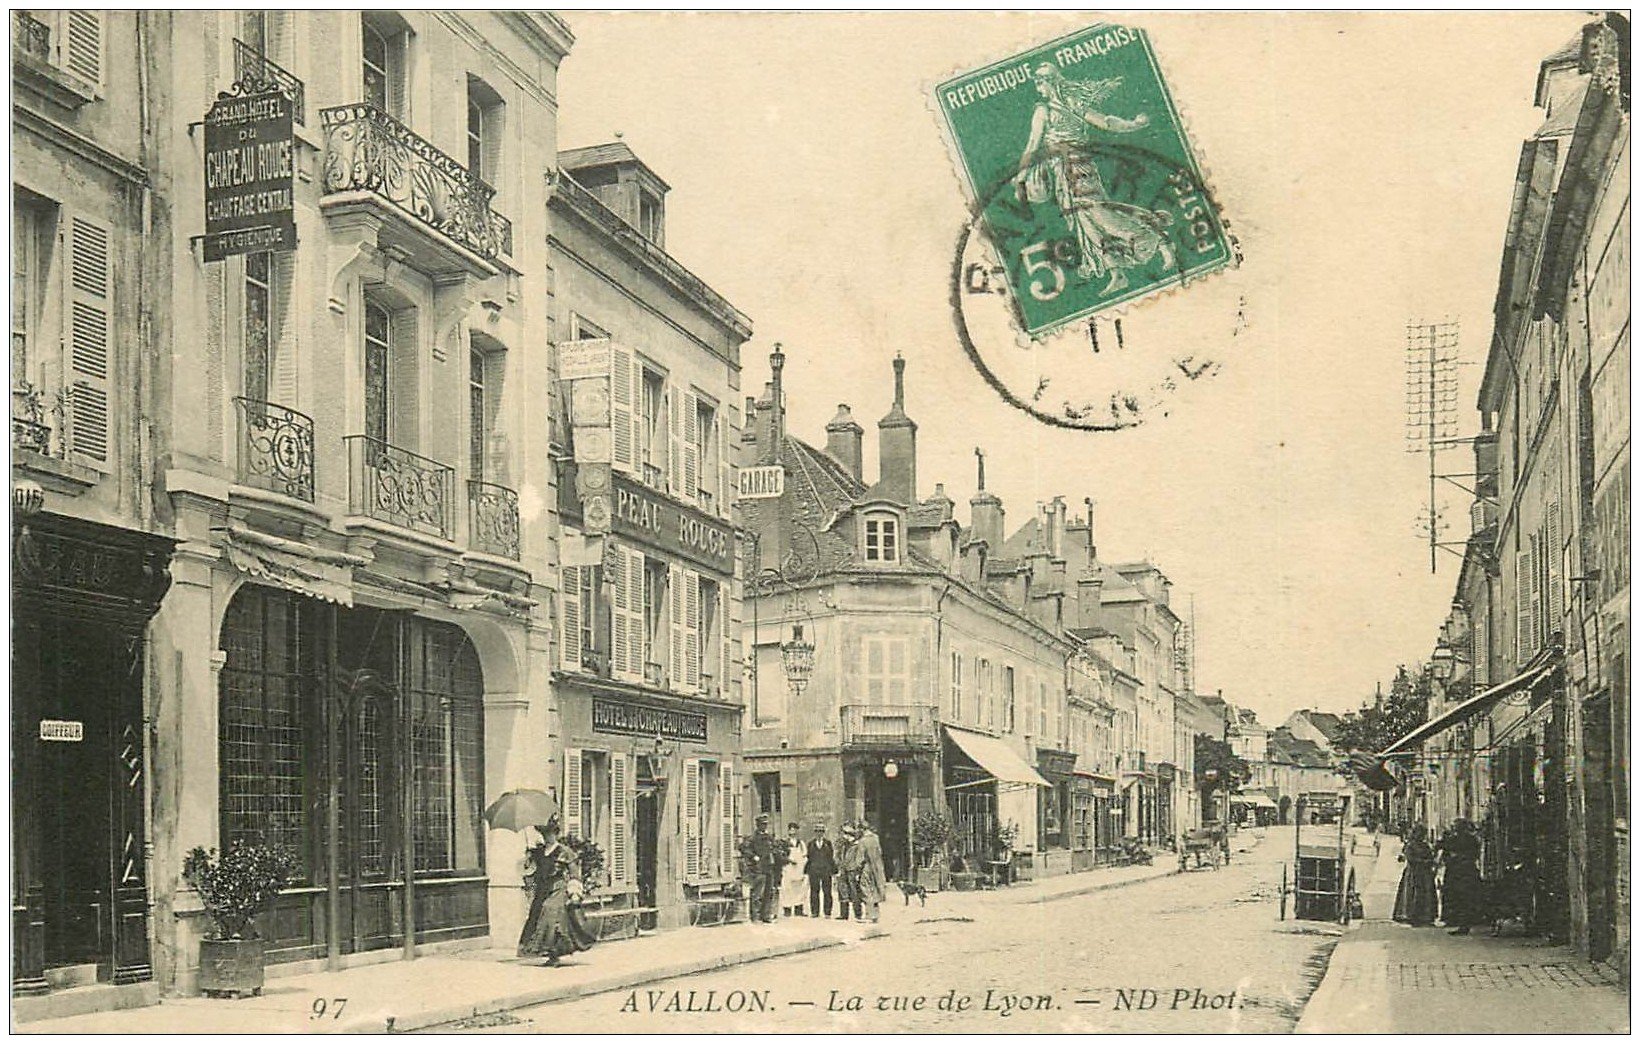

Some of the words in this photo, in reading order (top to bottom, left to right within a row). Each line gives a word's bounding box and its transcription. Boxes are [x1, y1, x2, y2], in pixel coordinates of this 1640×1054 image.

[1054, 26, 1139, 68] FRANÇAISE
[214, 102, 246, 127] GRAND
[249, 98, 284, 121] HOTEL
[239, 129, 256, 141] DU
[207, 147, 255, 188] CHAPEAU
[258, 139, 292, 181] ROUGE
[207, 194, 255, 220] CHAUFFAGE
[257, 188, 292, 213] CENTRAL
[1168, 167, 1217, 255] POSTES
[740, 468, 780, 495] GARAGE
[679, 514, 728, 558] ROUGE
[42, 723, 81, 738] COIFFEUR
[594, 700, 627, 728] HOTEL
[639, 706, 679, 734] CHAPEAU
